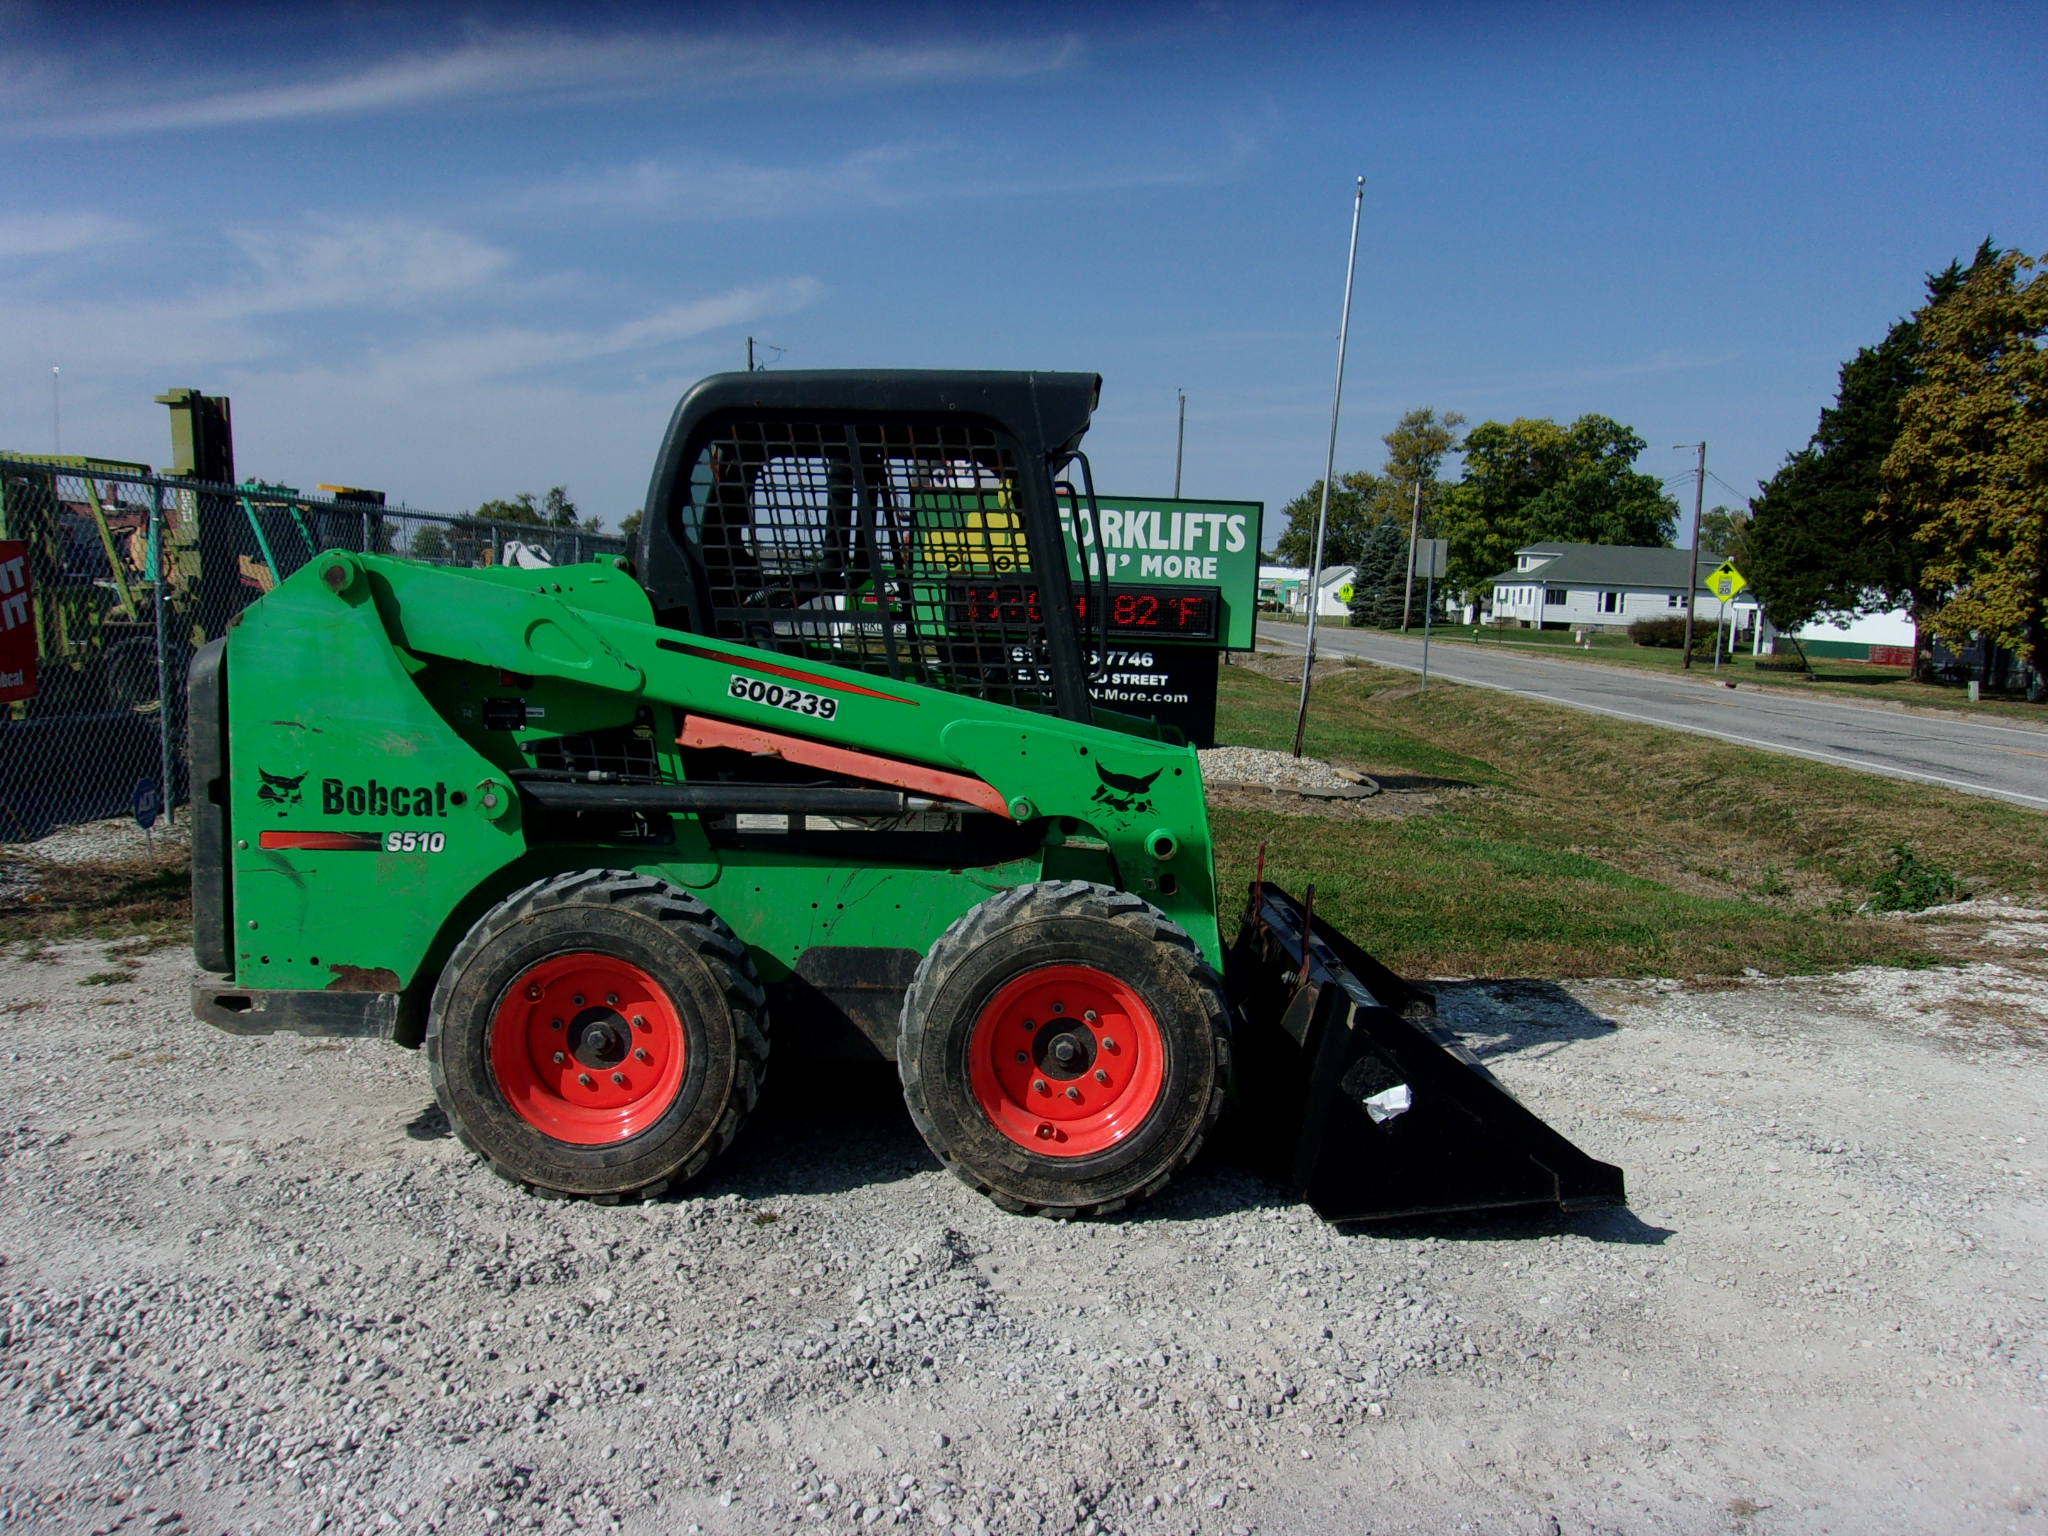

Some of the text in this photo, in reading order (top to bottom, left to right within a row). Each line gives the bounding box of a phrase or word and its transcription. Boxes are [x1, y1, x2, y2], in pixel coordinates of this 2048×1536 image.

[1140, 554, 1218, 580] MORE
[1114, 594, 1159, 625] 82
[1112, 673, 1169, 686] STREET
[730, 677, 836, 719] 600239
[322, 778, 448, 817] Bobcat
[386, 831, 447, 853] S510
